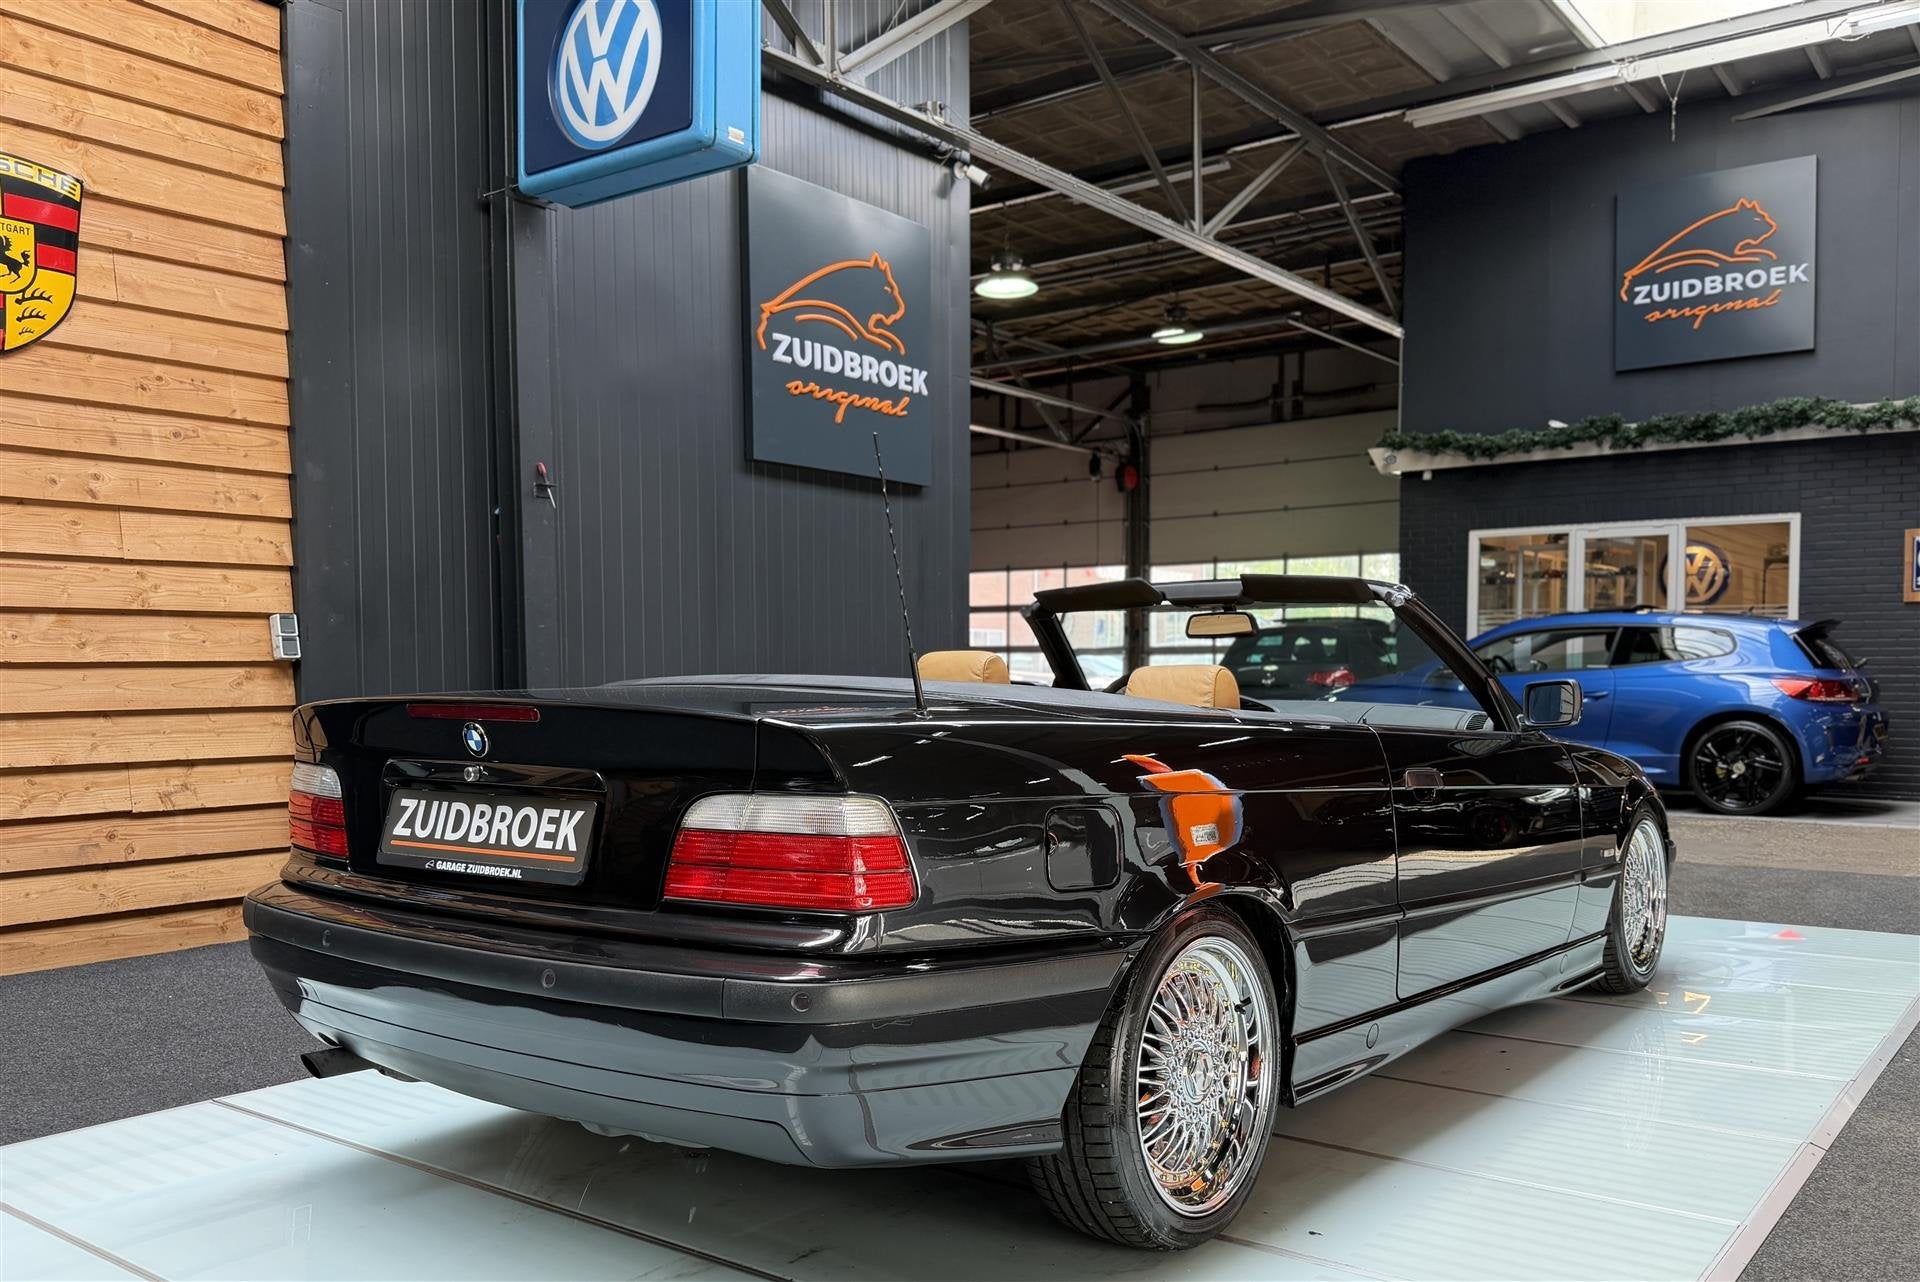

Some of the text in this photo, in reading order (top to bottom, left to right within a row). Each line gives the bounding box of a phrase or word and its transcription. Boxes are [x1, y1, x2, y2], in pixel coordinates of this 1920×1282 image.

[1633, 263, 1809, 305] ZUIDBROEK
[1644, 288, 1783, 330] original
[772, 332, 929, 396] ZUIDBROEK
[785, 379, 911, 424] original
[392, 798, 585, 852] ZUIDBROEK
[436, 860, 522, 879] GARAGE ZUIDBROEK.NL
